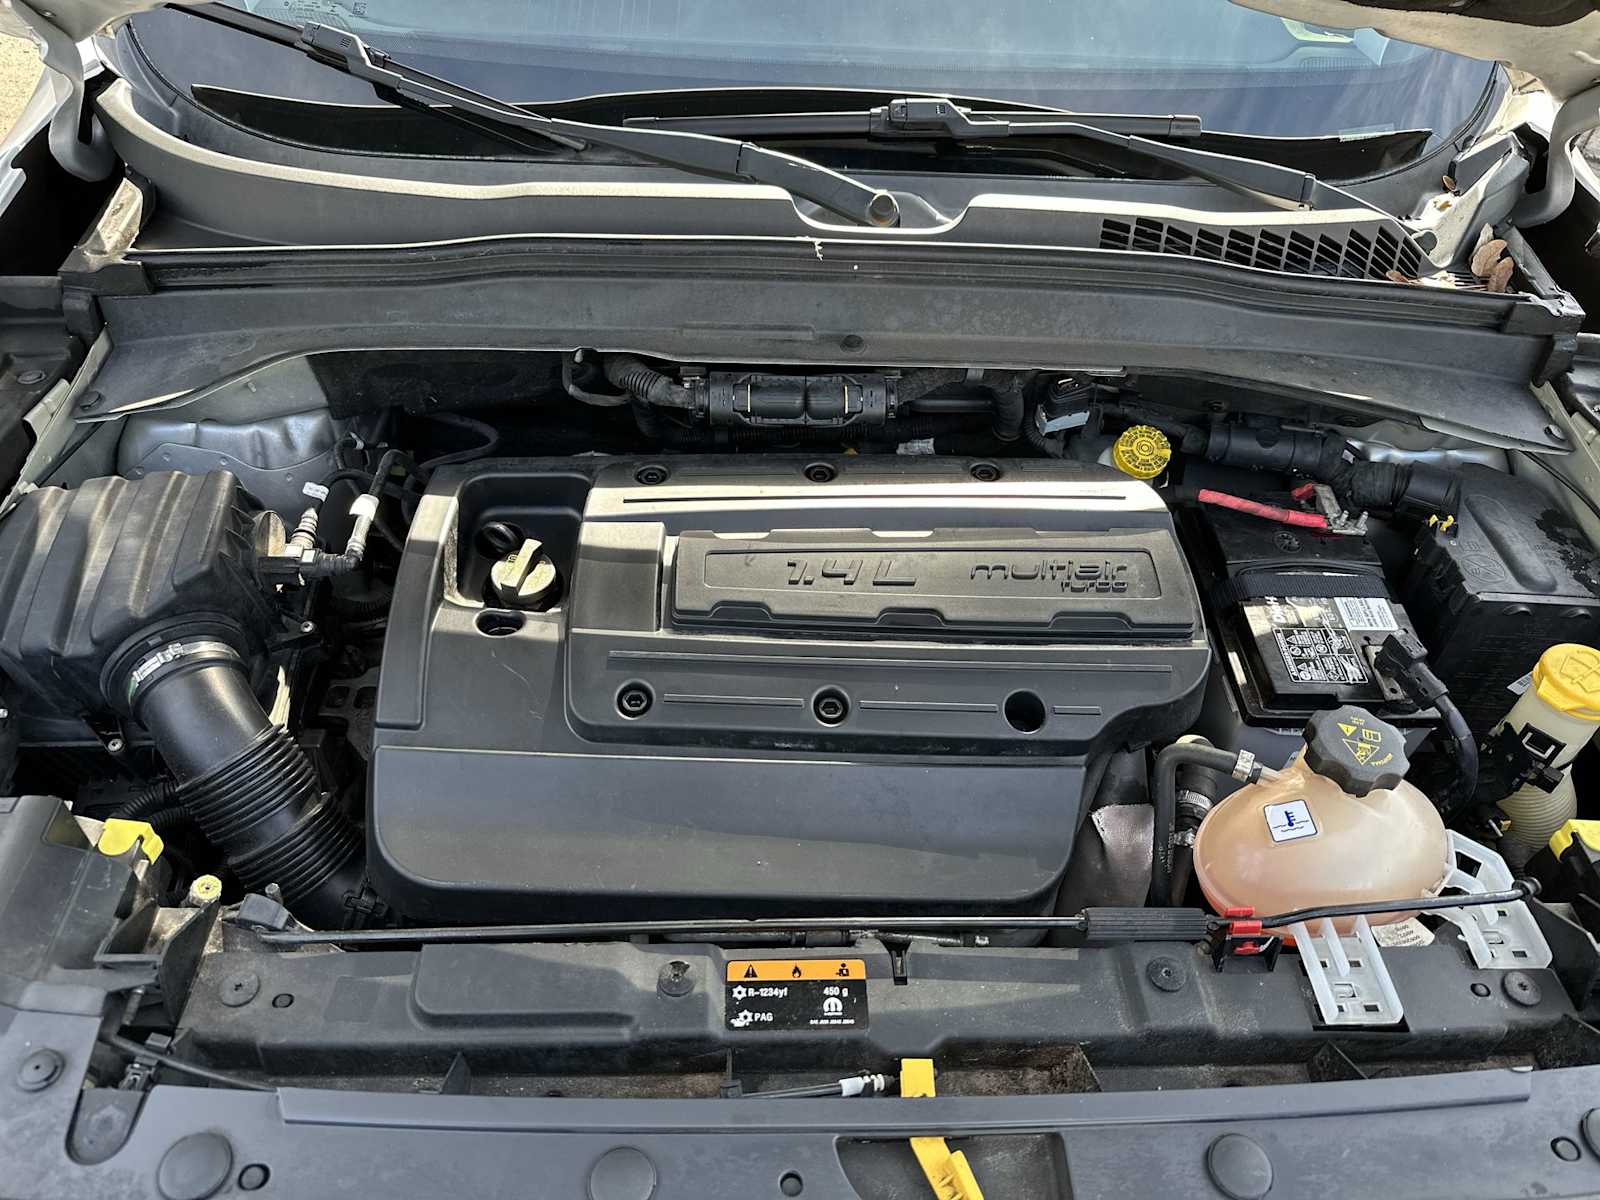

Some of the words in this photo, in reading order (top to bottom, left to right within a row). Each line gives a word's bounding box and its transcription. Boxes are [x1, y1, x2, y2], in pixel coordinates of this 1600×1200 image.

[970, 560, 1128, 580] multiair
[1060, 581, 1128, 593] turbo
[823, 986, 839, 996] 450
[842, 987, 848, 997] g
[754, 1012, 773, 1022] PAG
